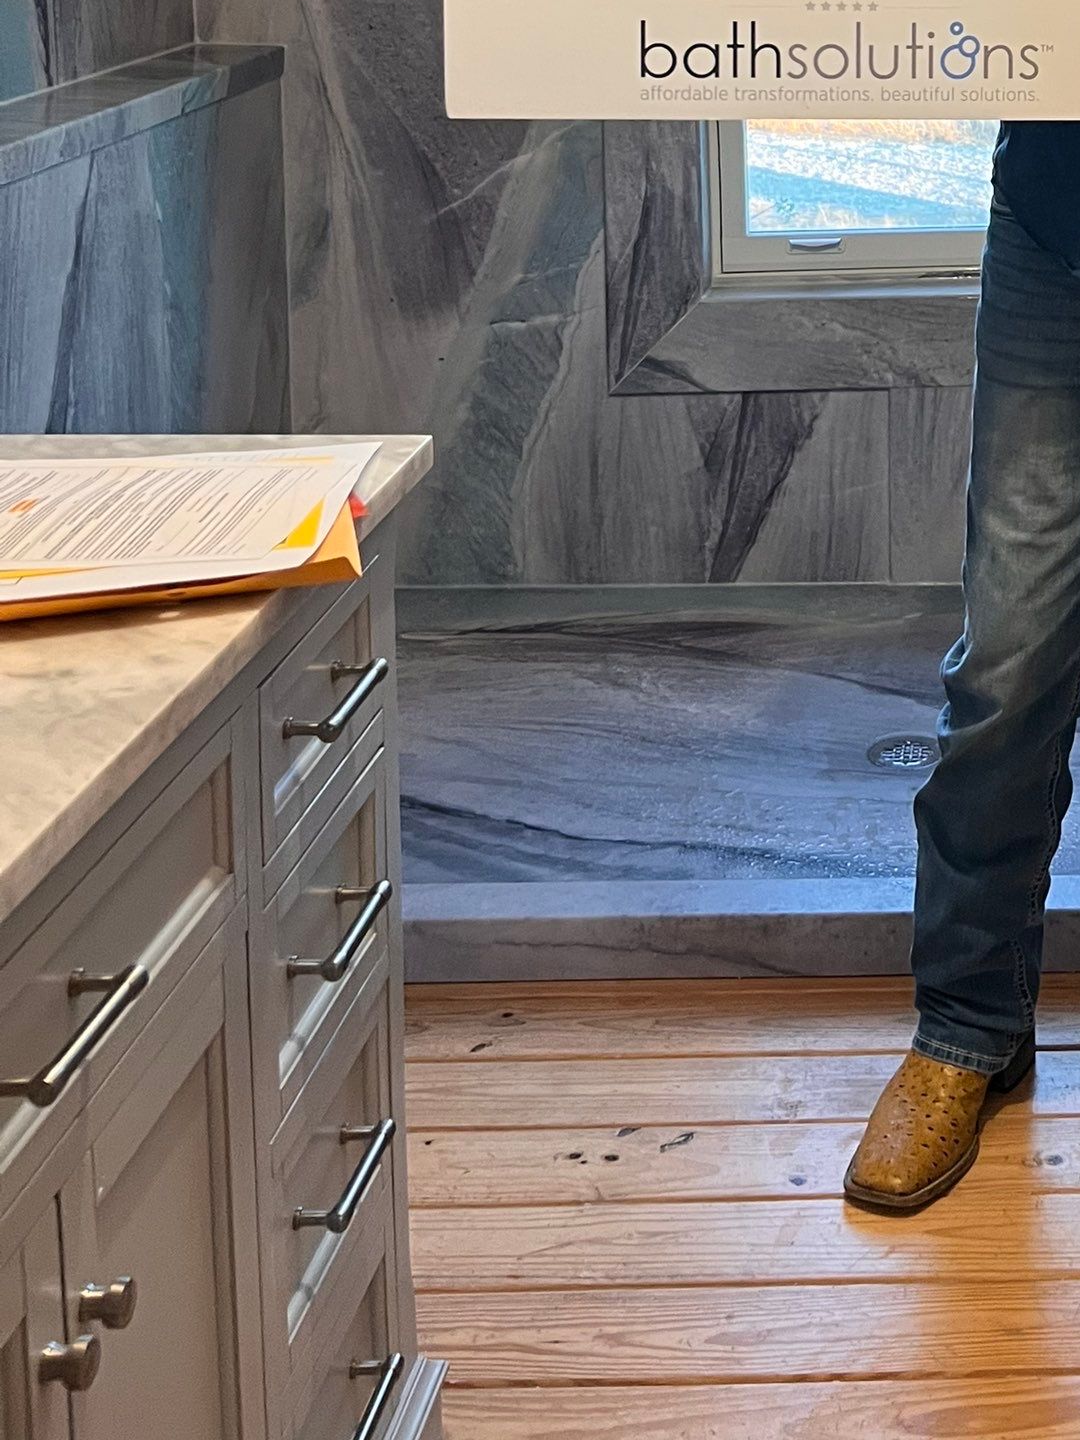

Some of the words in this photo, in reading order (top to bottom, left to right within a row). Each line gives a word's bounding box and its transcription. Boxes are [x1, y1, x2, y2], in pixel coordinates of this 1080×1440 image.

[640, 85, 729, 102] affordable
[734, 86, 874, 103] transformations.
[881, 86, 956, 102] beautiful
[960, 86, 1040, 103] solutions.
